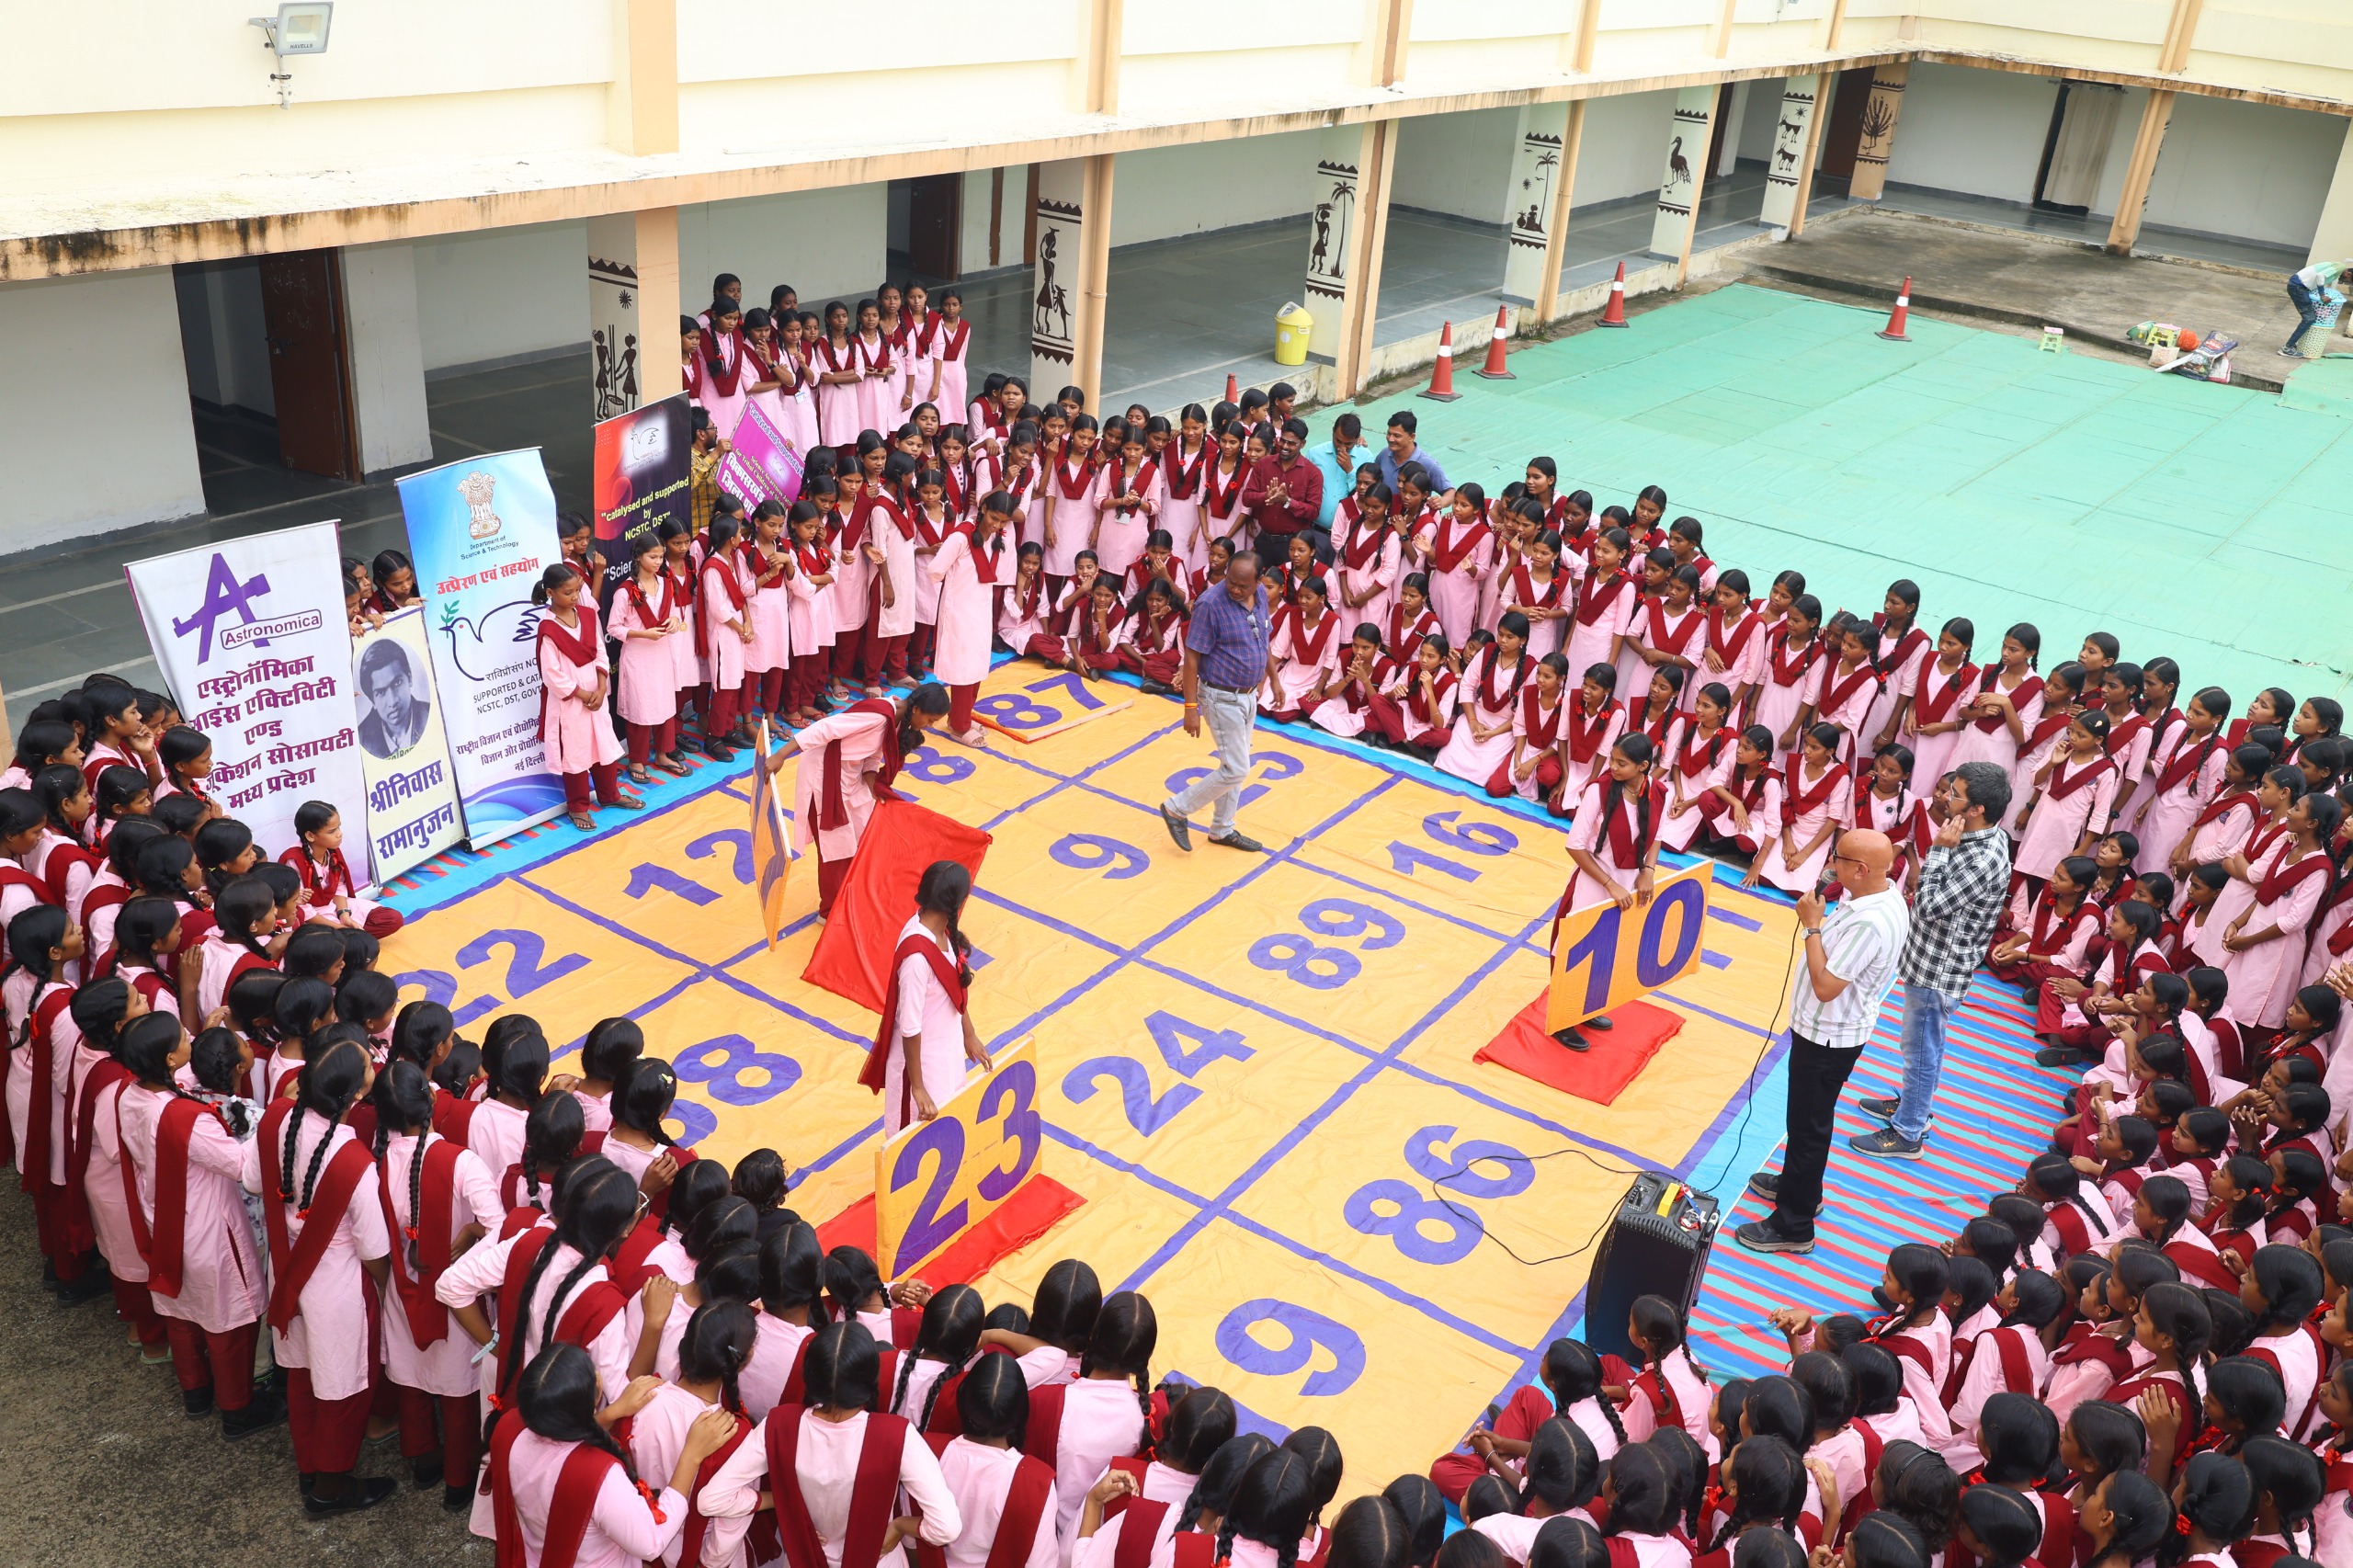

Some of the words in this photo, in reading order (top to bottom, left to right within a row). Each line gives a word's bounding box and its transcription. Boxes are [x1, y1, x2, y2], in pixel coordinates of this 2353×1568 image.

[601, 498, 641, 522] "catalysed
[642, 491, 654, 506] and
[654, 476, 689, 499] supported
[643, 507, 652, 519] by
[460, 551, 481, 561] Science
[487, 540, 519, 553] Technology
[470, 537, 499, 550] Department
[625, 521, 652, 541] NCSTC,
[479, 564, 497, 583] एवं
[500, 557, 540, 577] सहयोग
[224, 613, 320, 646] Astronomica
[197, 655, 314, 699] एस्ट्रोनॉमिका
[244, 676, 336, 715] एक्टिविटी
[473, 681, 517, 703] SUPPORTED
[518, 678, 525, 687] &
[477, 699, 504, 715] NCSTC,
[505, 693, 520, 706] DST,
[973, 672, 1107, 730] 87
[244, 721, 283, 745] एण्ड
[267, 728, 355, 766] सोसायटी
[456, 740, 479, 755] राष्ट्रीय
[479, 732, 501, 748] विज्ञान
[502, 725, 513, 739] एवं
[481, 751, 503, 766] विज्ञान
[505, 744, 517, 757] और
[515, 758, 525, 771] नई
[227, 781, 263, 809] मध्य
[267, 767, 316, 794] प्रदेश
[369, 759, 443, 812] श्रीनिवास
[376, 801, 455, 859] रामानुजन
[1385, 811, 1519, 883] 16
[1049, 833, 1151, 880] 9
[1247, 898, 1406, 990] 89
[1565, 879, 1705, 1017] 10
[1062, 1010, 1257, 1138] 24
[889, 1060, 1041, 1279] 23
[1343, 1125, 1536, 1266] 86
